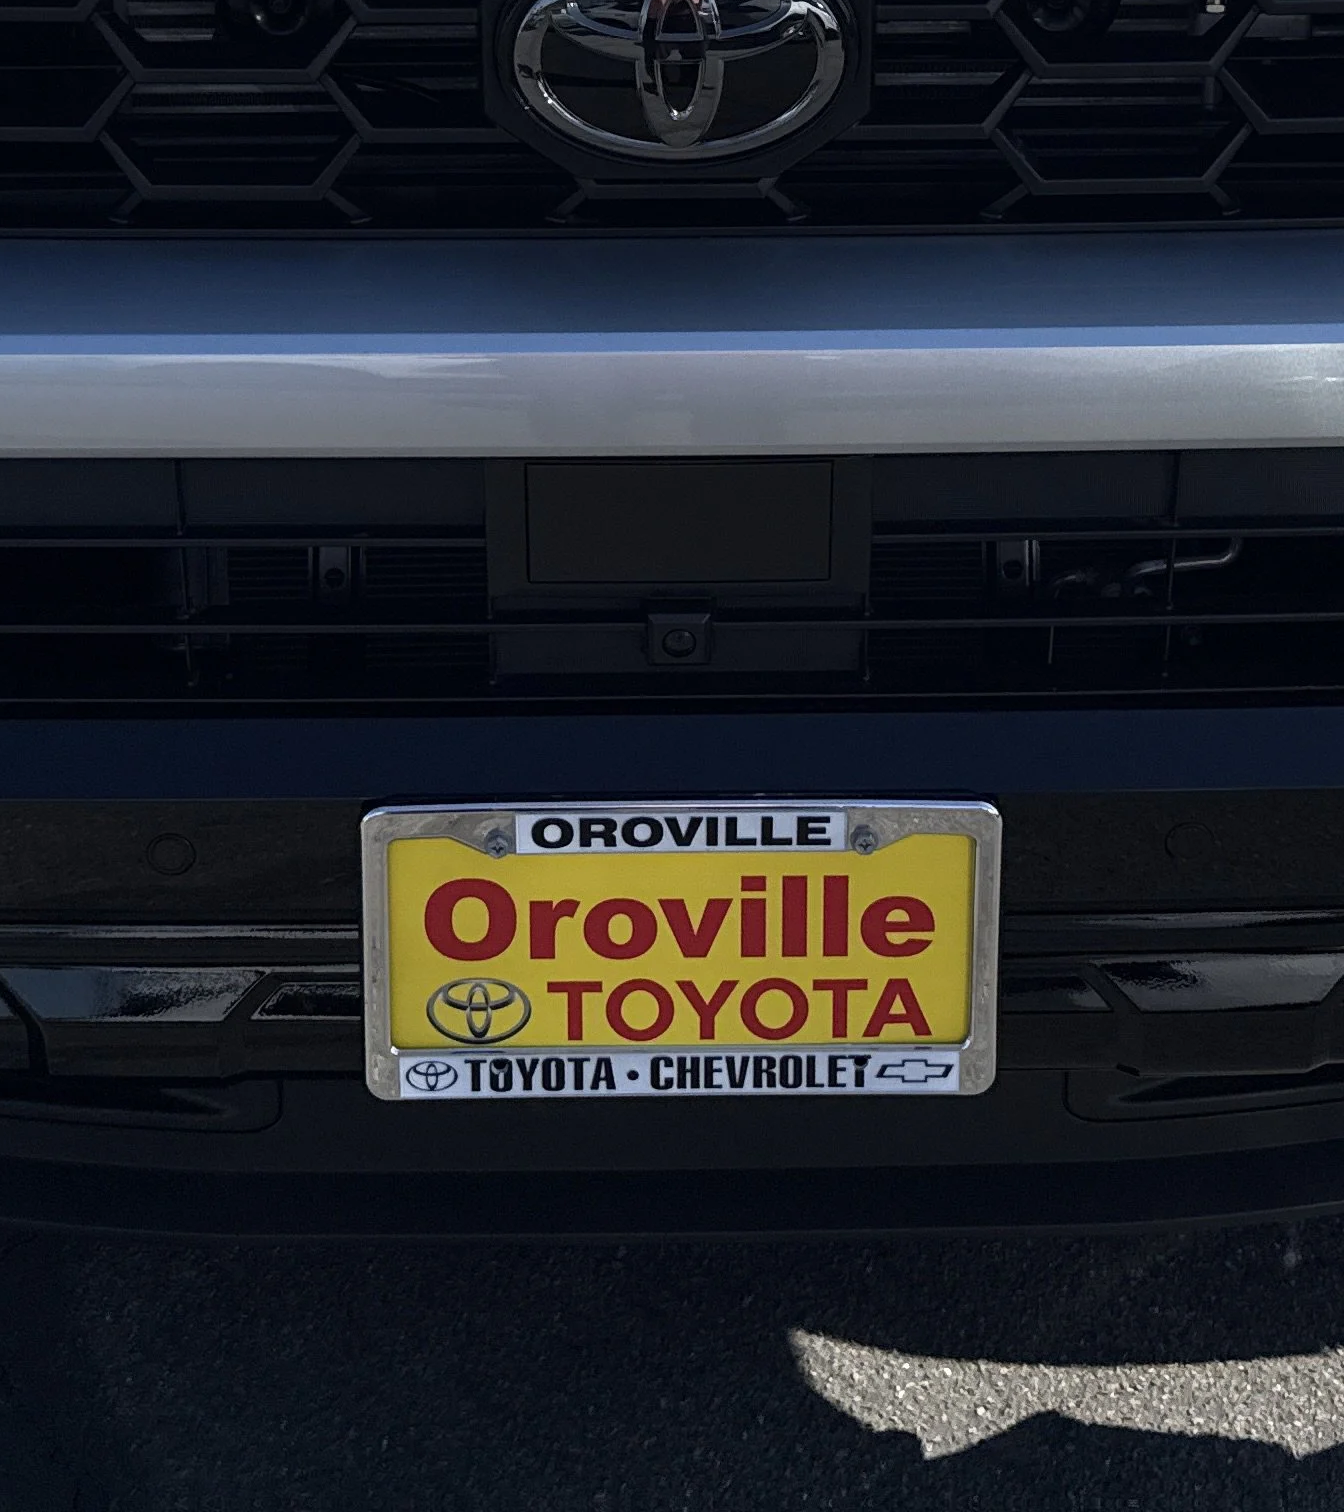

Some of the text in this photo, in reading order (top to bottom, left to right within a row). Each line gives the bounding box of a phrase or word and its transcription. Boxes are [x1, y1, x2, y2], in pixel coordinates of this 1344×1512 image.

[530, 815, 832, 849] OROVILLE
[423, 875, 936, 961] Oroville
[547, 978, 933, 1042] TOYOTA
[465, 1054, 873, 1092] TOYOTA CHEVROLET
